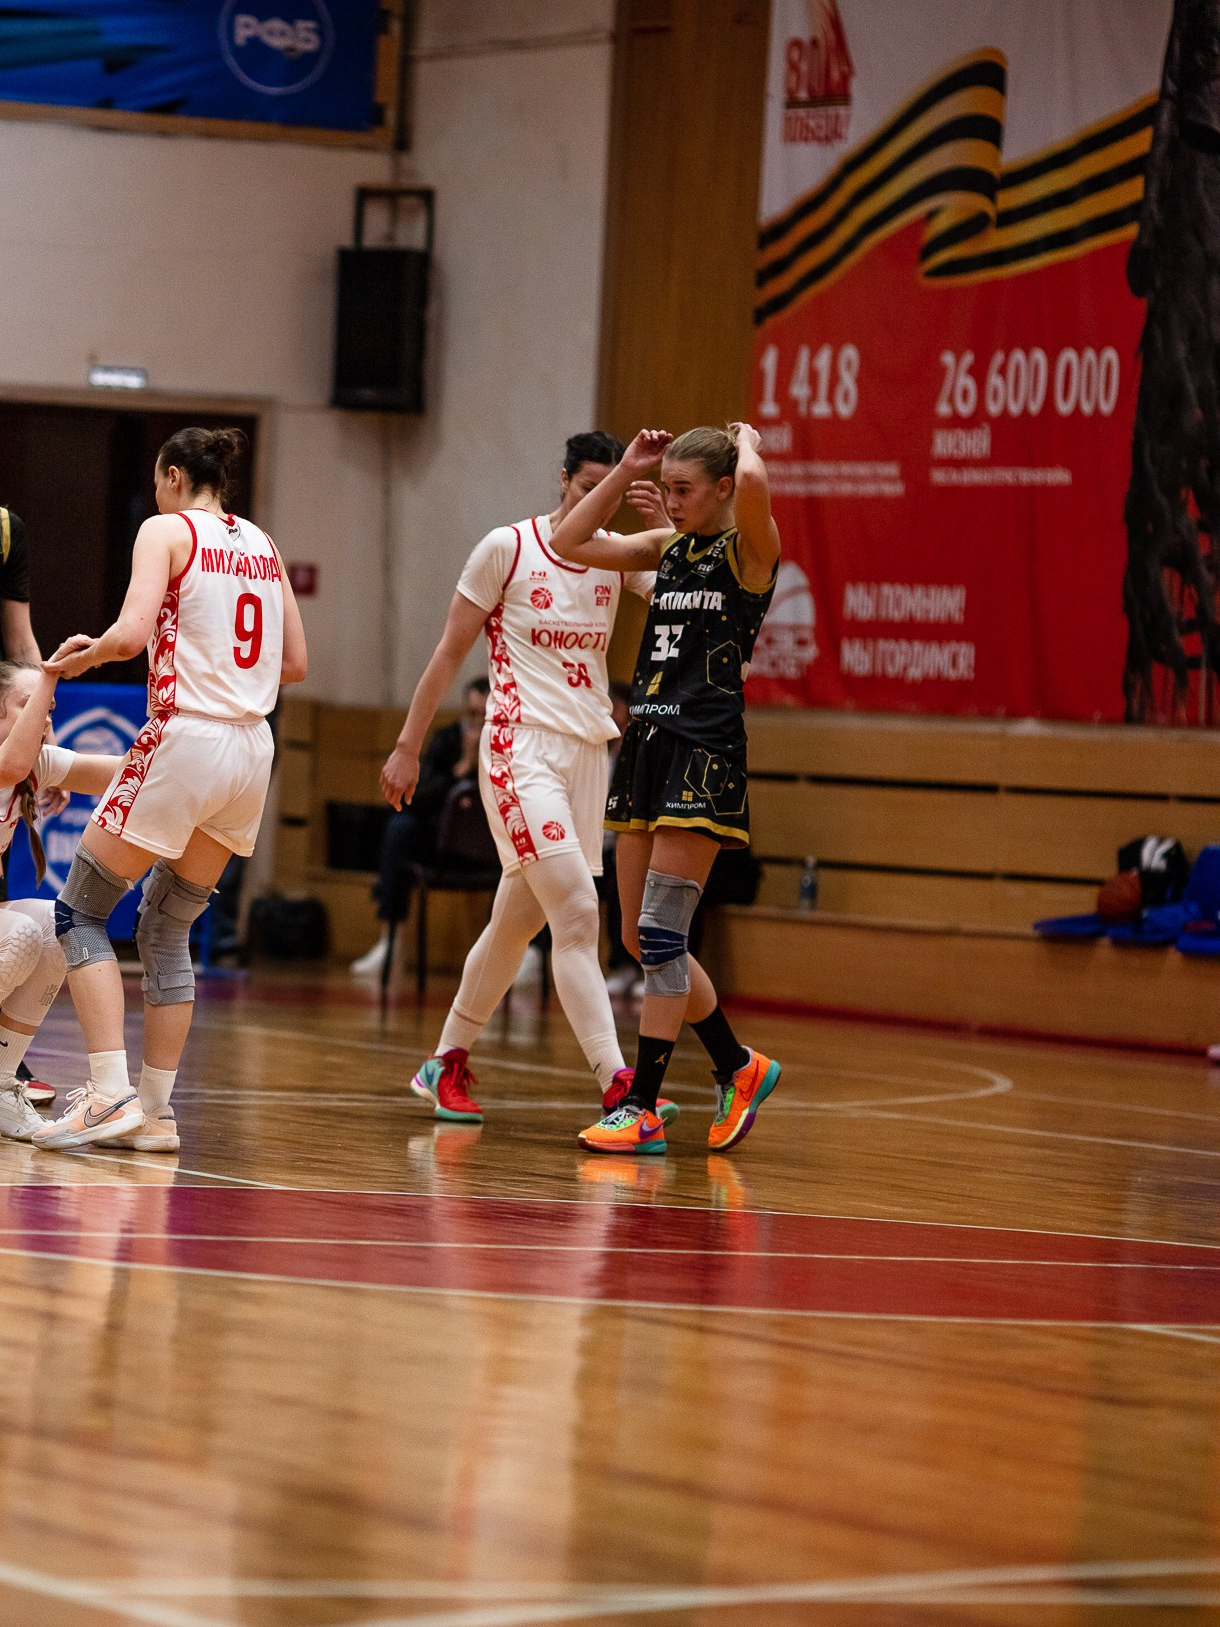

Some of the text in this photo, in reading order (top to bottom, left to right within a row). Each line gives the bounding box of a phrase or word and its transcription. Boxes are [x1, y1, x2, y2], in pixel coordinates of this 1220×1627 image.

[234, 13, 321, 53] РФБ
[936, 345, 1120, 418] 26 600 000
[594, 585, 611, 595] FON
[596, 596, 610, 606] BET
[649, 589, 723, 611] -АТЛАНТА
[233, 592, 262, 669] 9
[665, 801, 706, 810] ХИМПРОМ
